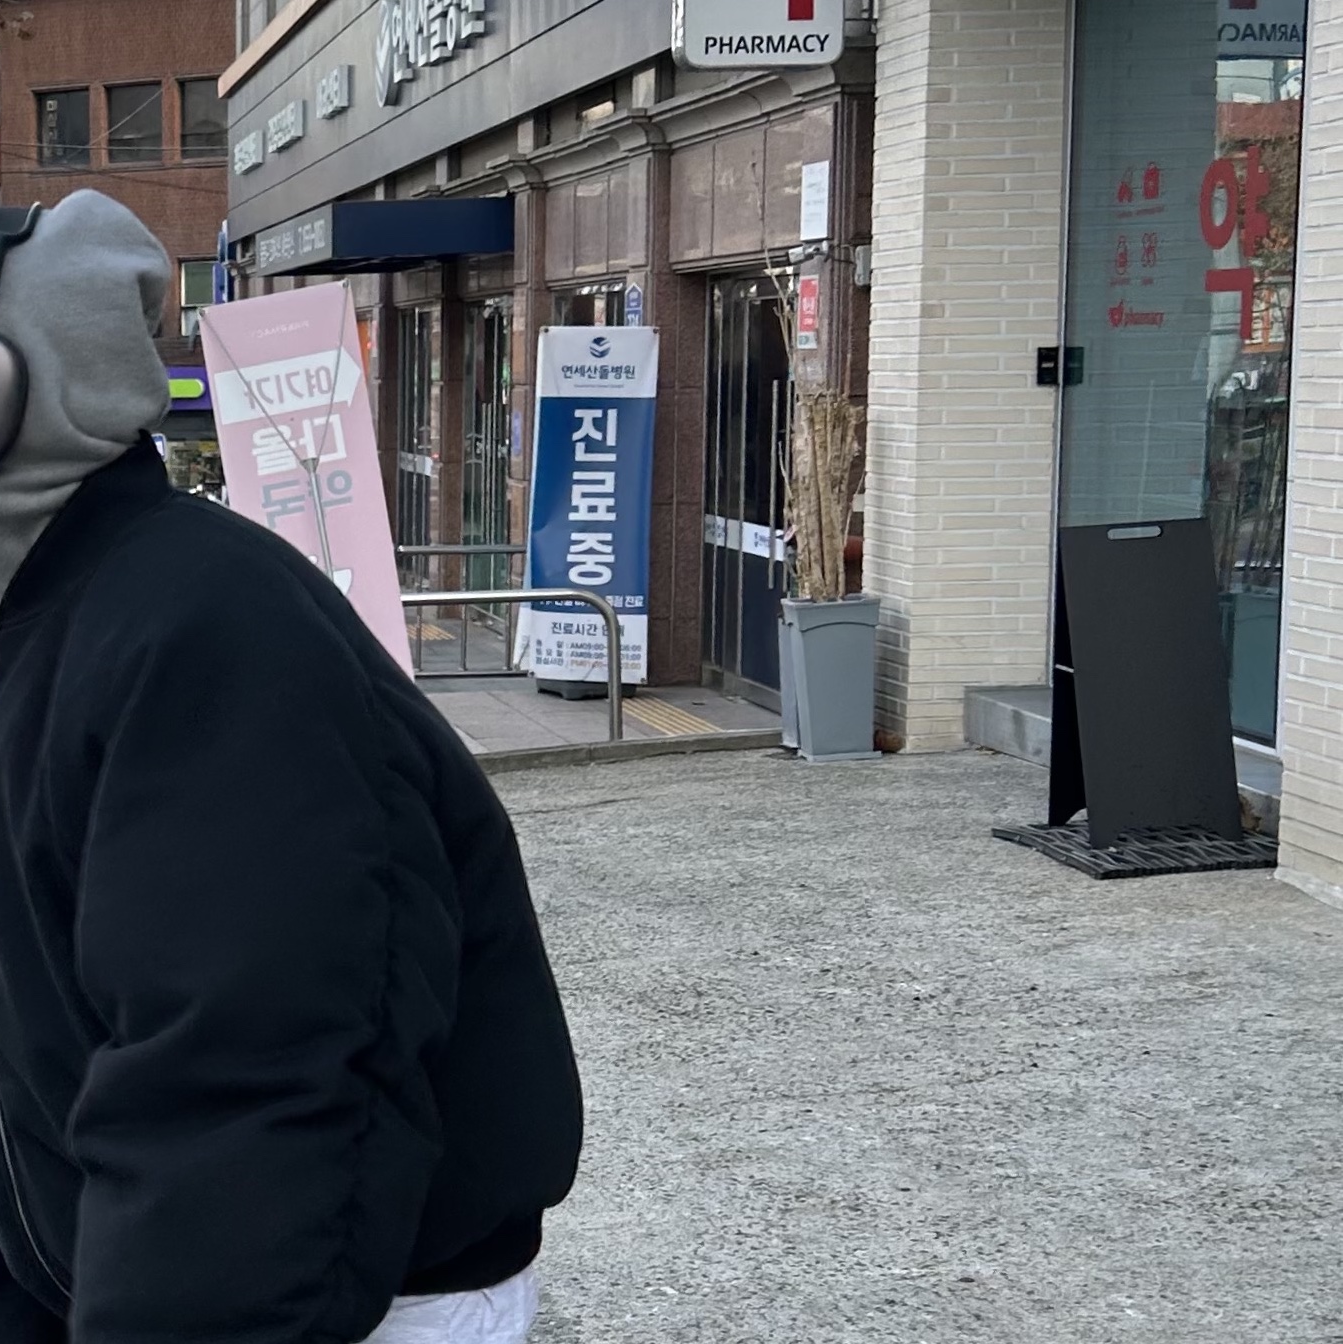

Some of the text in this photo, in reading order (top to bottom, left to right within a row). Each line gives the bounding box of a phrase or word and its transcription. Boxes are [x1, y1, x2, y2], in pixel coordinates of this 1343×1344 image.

[704, 34, 830, 55] PHARMACY
[1198, 146, 1271, 339] 약
[561, 364, 636, 380] 연세산돌병원
[566, 408, 618, 586] 진료중
[624, 595, 644, 608] 진료
[551, 621, 598, 637] 진료시간
